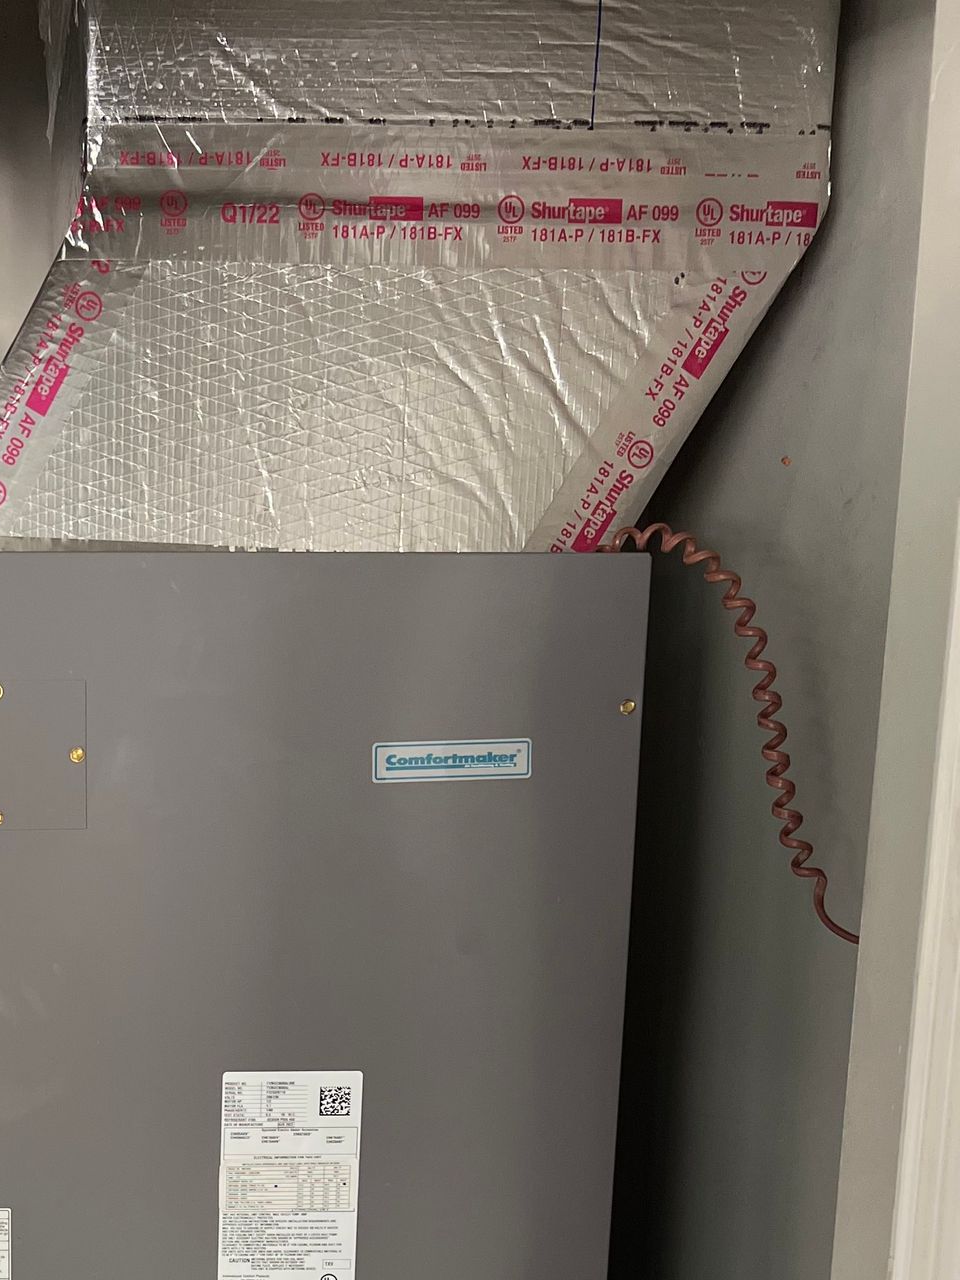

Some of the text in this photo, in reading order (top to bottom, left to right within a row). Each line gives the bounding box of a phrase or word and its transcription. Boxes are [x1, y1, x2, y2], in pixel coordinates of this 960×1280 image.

[199, 151, 252, 166] 181A-P
[320, 153, 452, 168] 181A-P / 181B-FX
[460, 161, 487, 171] LISTED
[522, 155, 652, 172] 181A-P / 181B-FX
[660, 166, 687, 176] LISTED
[795, 170, 821, 180] LISTED
[220, 202, 281, 224] Q1/22
[332, 199, 481, 220] Shurtape AF 099
[530, 201, 679, 224] Shurtape AF 099
[729, 203, 803, 226] Shurtape
[160, 218, 187, 227] LISTED
[298, 222, 324, 231] LISTED
[497, 225, 523, 235] LISTED
[332, 225, 463, 242] 181A-P / 181B-FX
[531, 228, 661, 243] 181A-P / 181B-FX
[695, 228, 721, 238] LISTED
[729, 231, 781, 246] 181A-P
[645, 276, 728, 401] 181A-P 181B-FX
[652, 285, 747, 428] Shurtape AF 099
[2, 322, 85, 466] Shurtape AF 099
[616, 431, 636, 458] LISTED
[550, 459, 615, 552] 181A-P 181B
[584, 469, 634, 538] Shurtape
[385, 751, 518, 766] Comfortmaker
